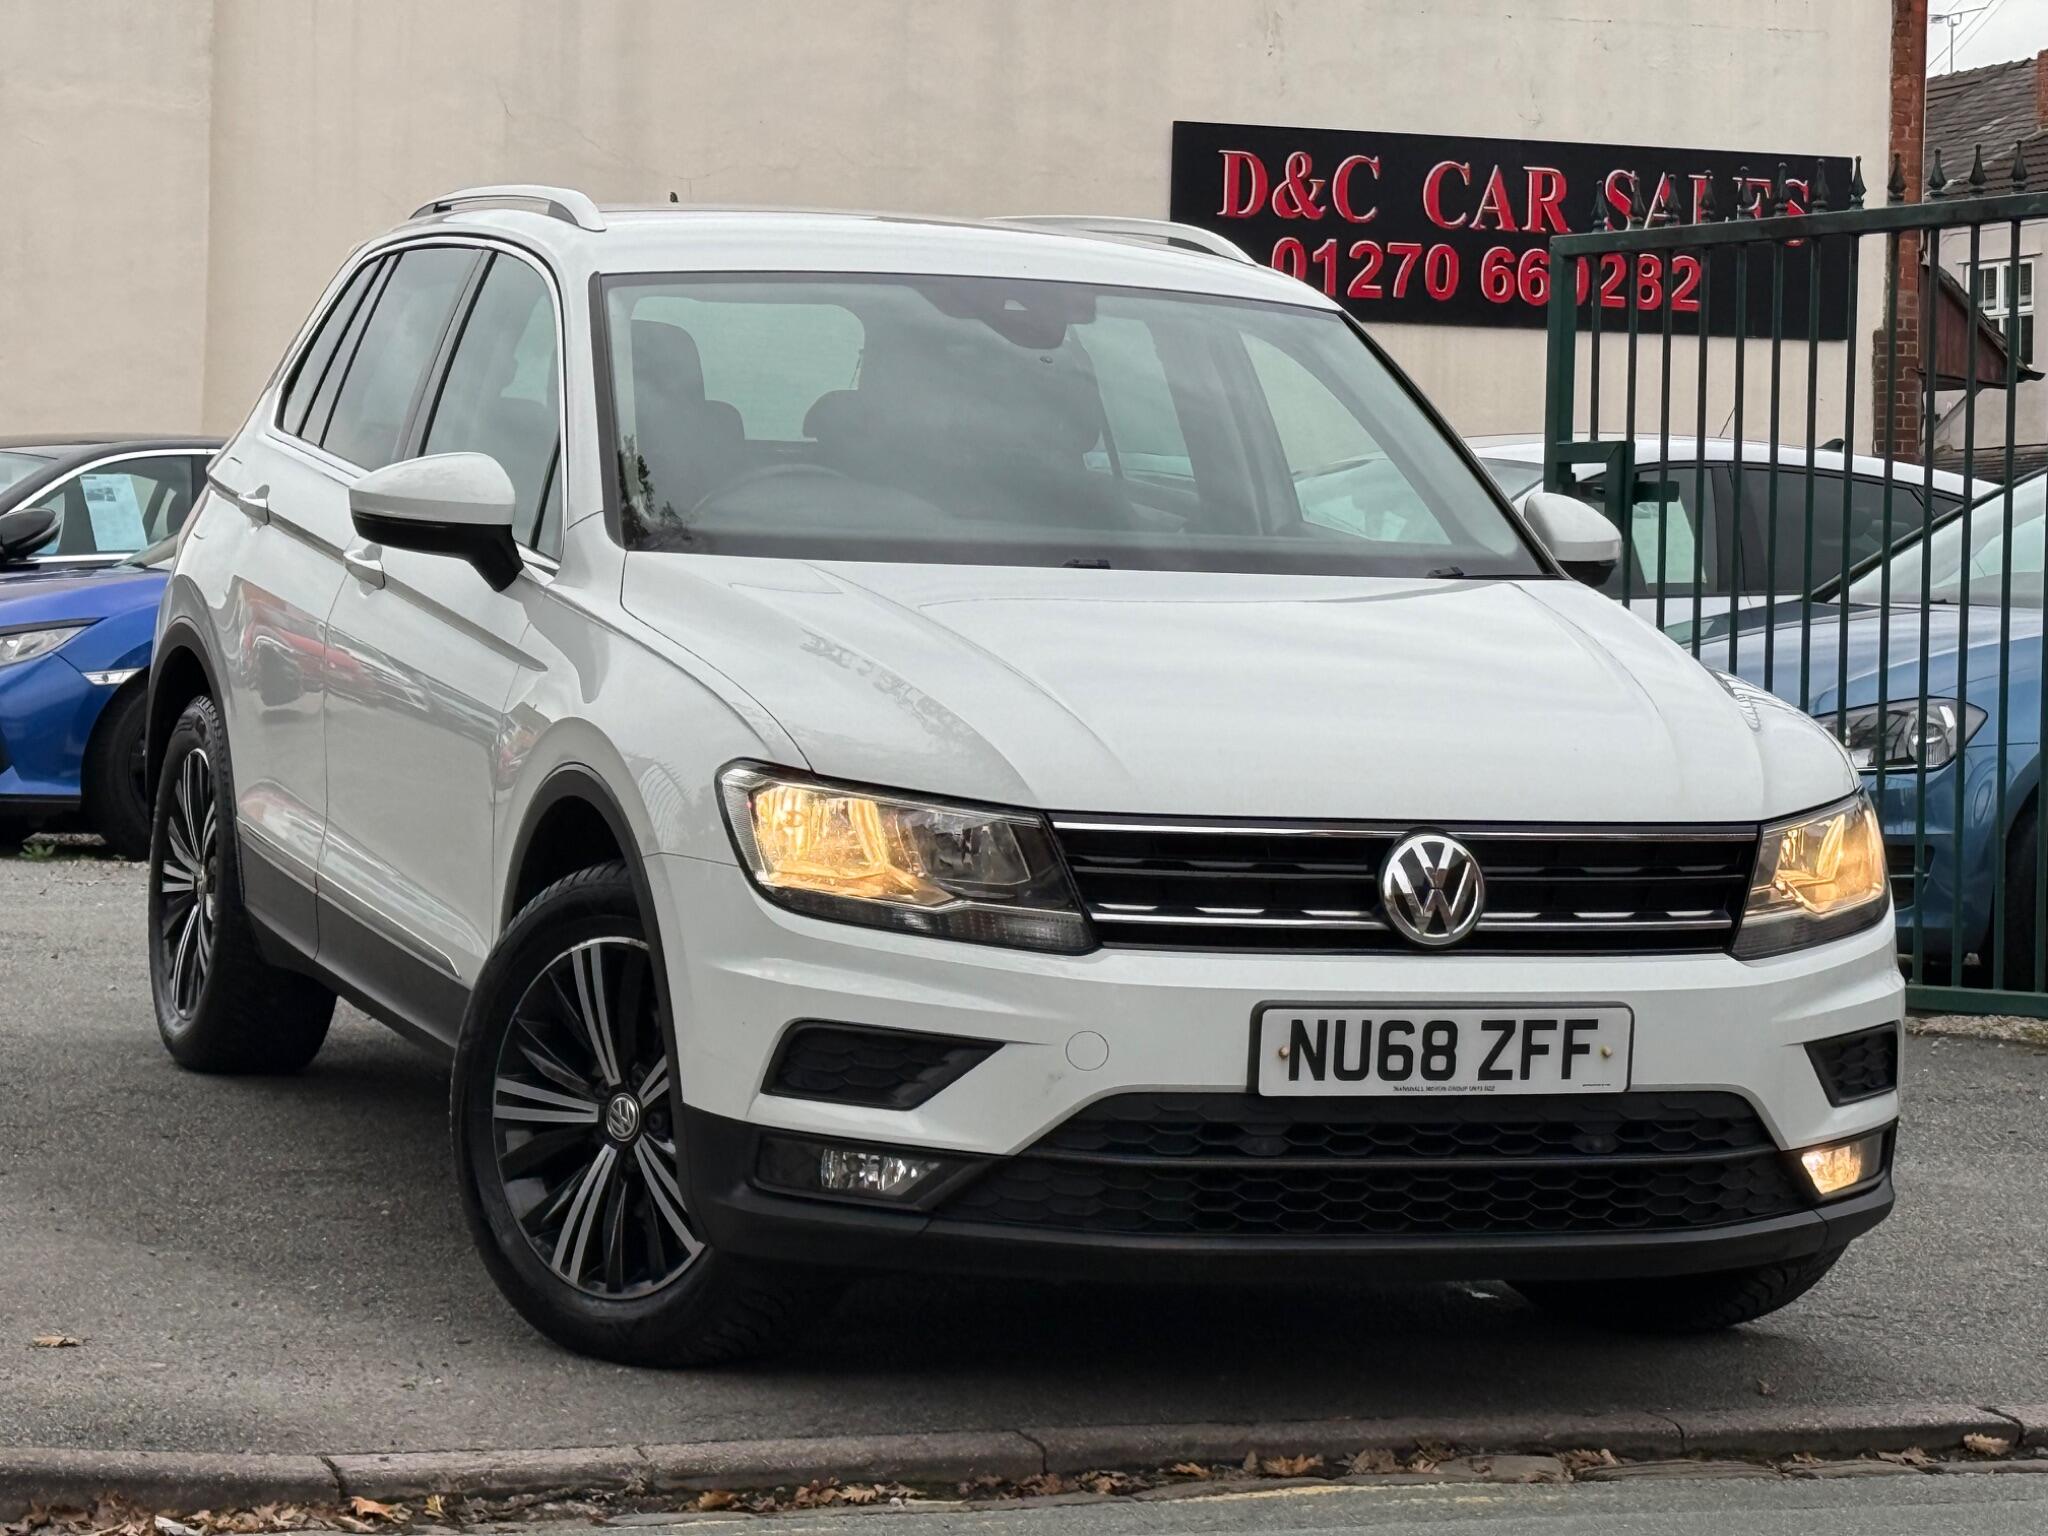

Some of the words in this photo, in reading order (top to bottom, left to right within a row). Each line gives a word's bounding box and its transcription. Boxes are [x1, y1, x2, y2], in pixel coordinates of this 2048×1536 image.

[1216, 150, 1381, 223] D&C
[1423, 160, 1572, 233] CAR
[1271, 236, 1460, 302] 01270
[1288, 1019, 1458, 1082] NU68
[1477, 1018, 1599, 1081] ZFF
